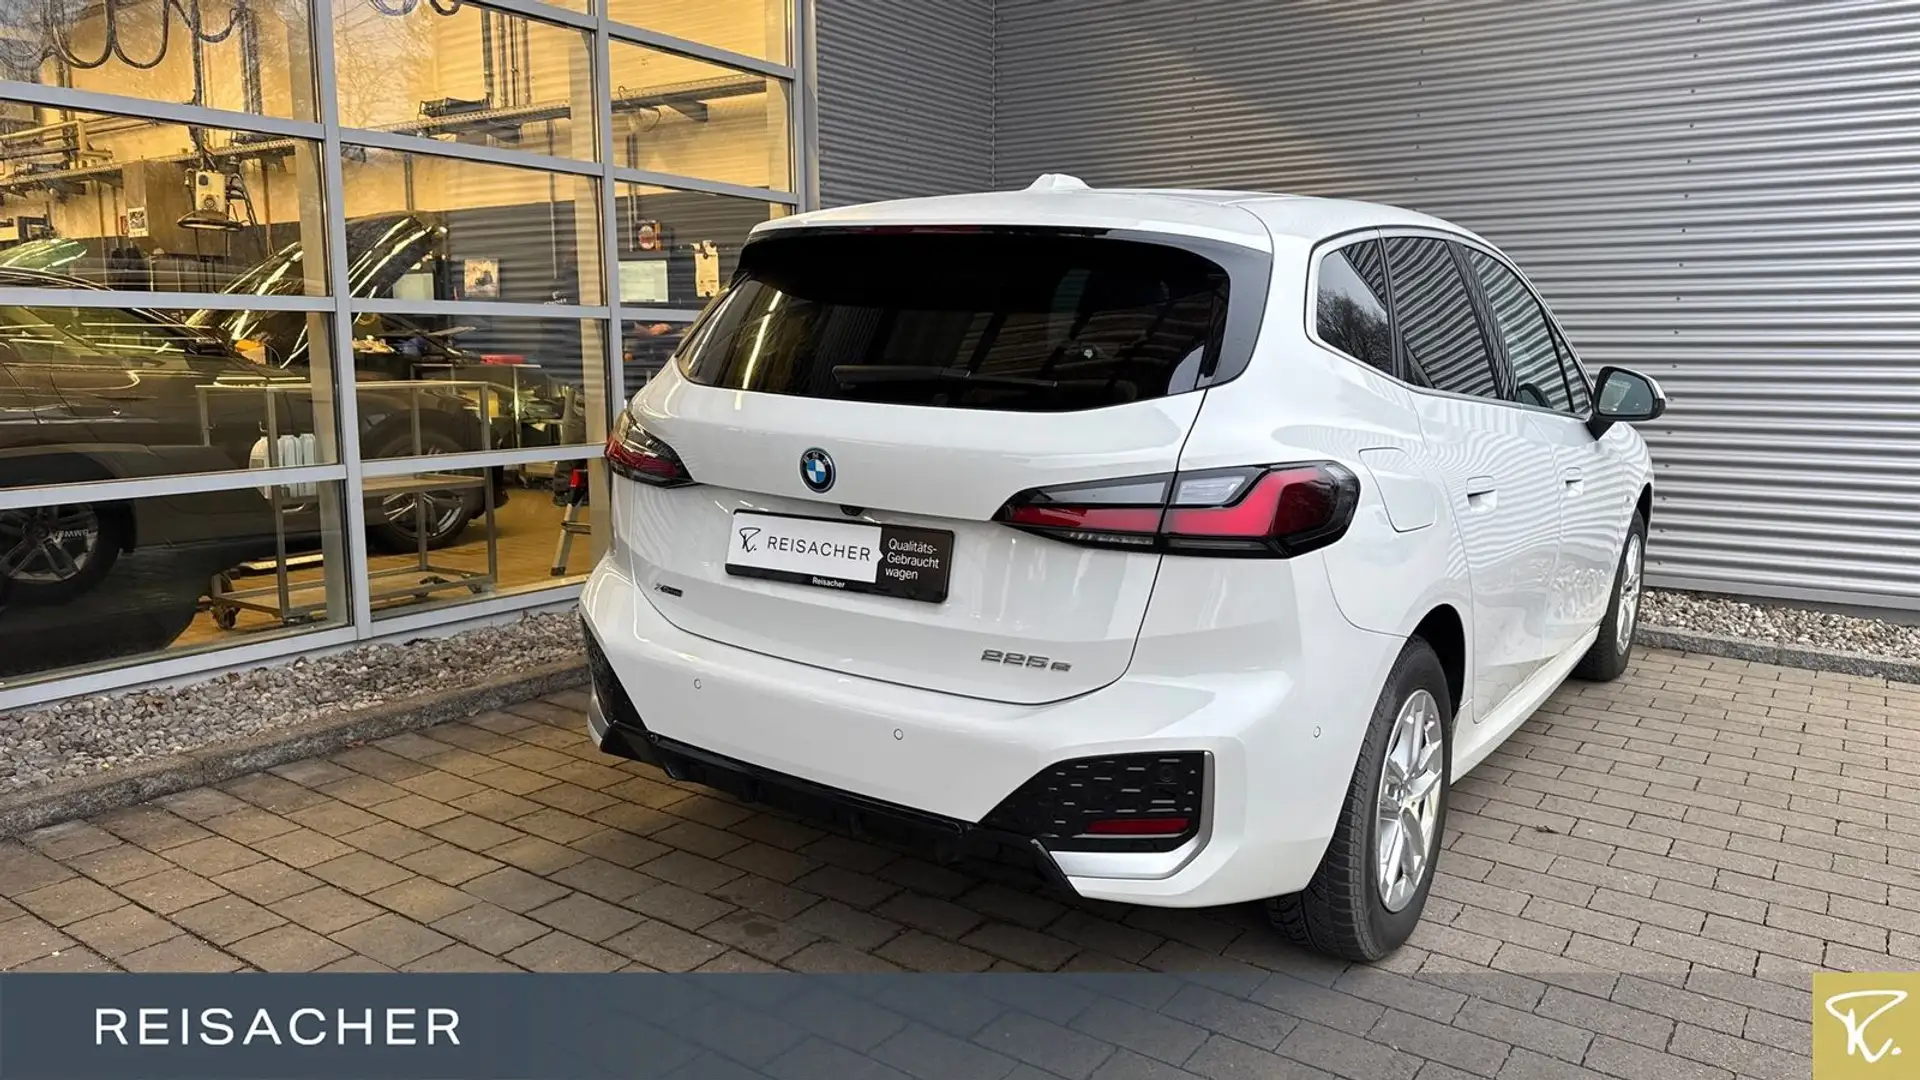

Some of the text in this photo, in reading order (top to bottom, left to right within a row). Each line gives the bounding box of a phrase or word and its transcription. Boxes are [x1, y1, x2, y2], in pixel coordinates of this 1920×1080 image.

[767, 535, 871, 561] REISACHER
[888, 537, 938, 554] Qualitäts-
[887, 551, 939, 569] Gebraucht
[812, 576, 845, 588] Reisacher
[885, 567, 918, 581] wagen
